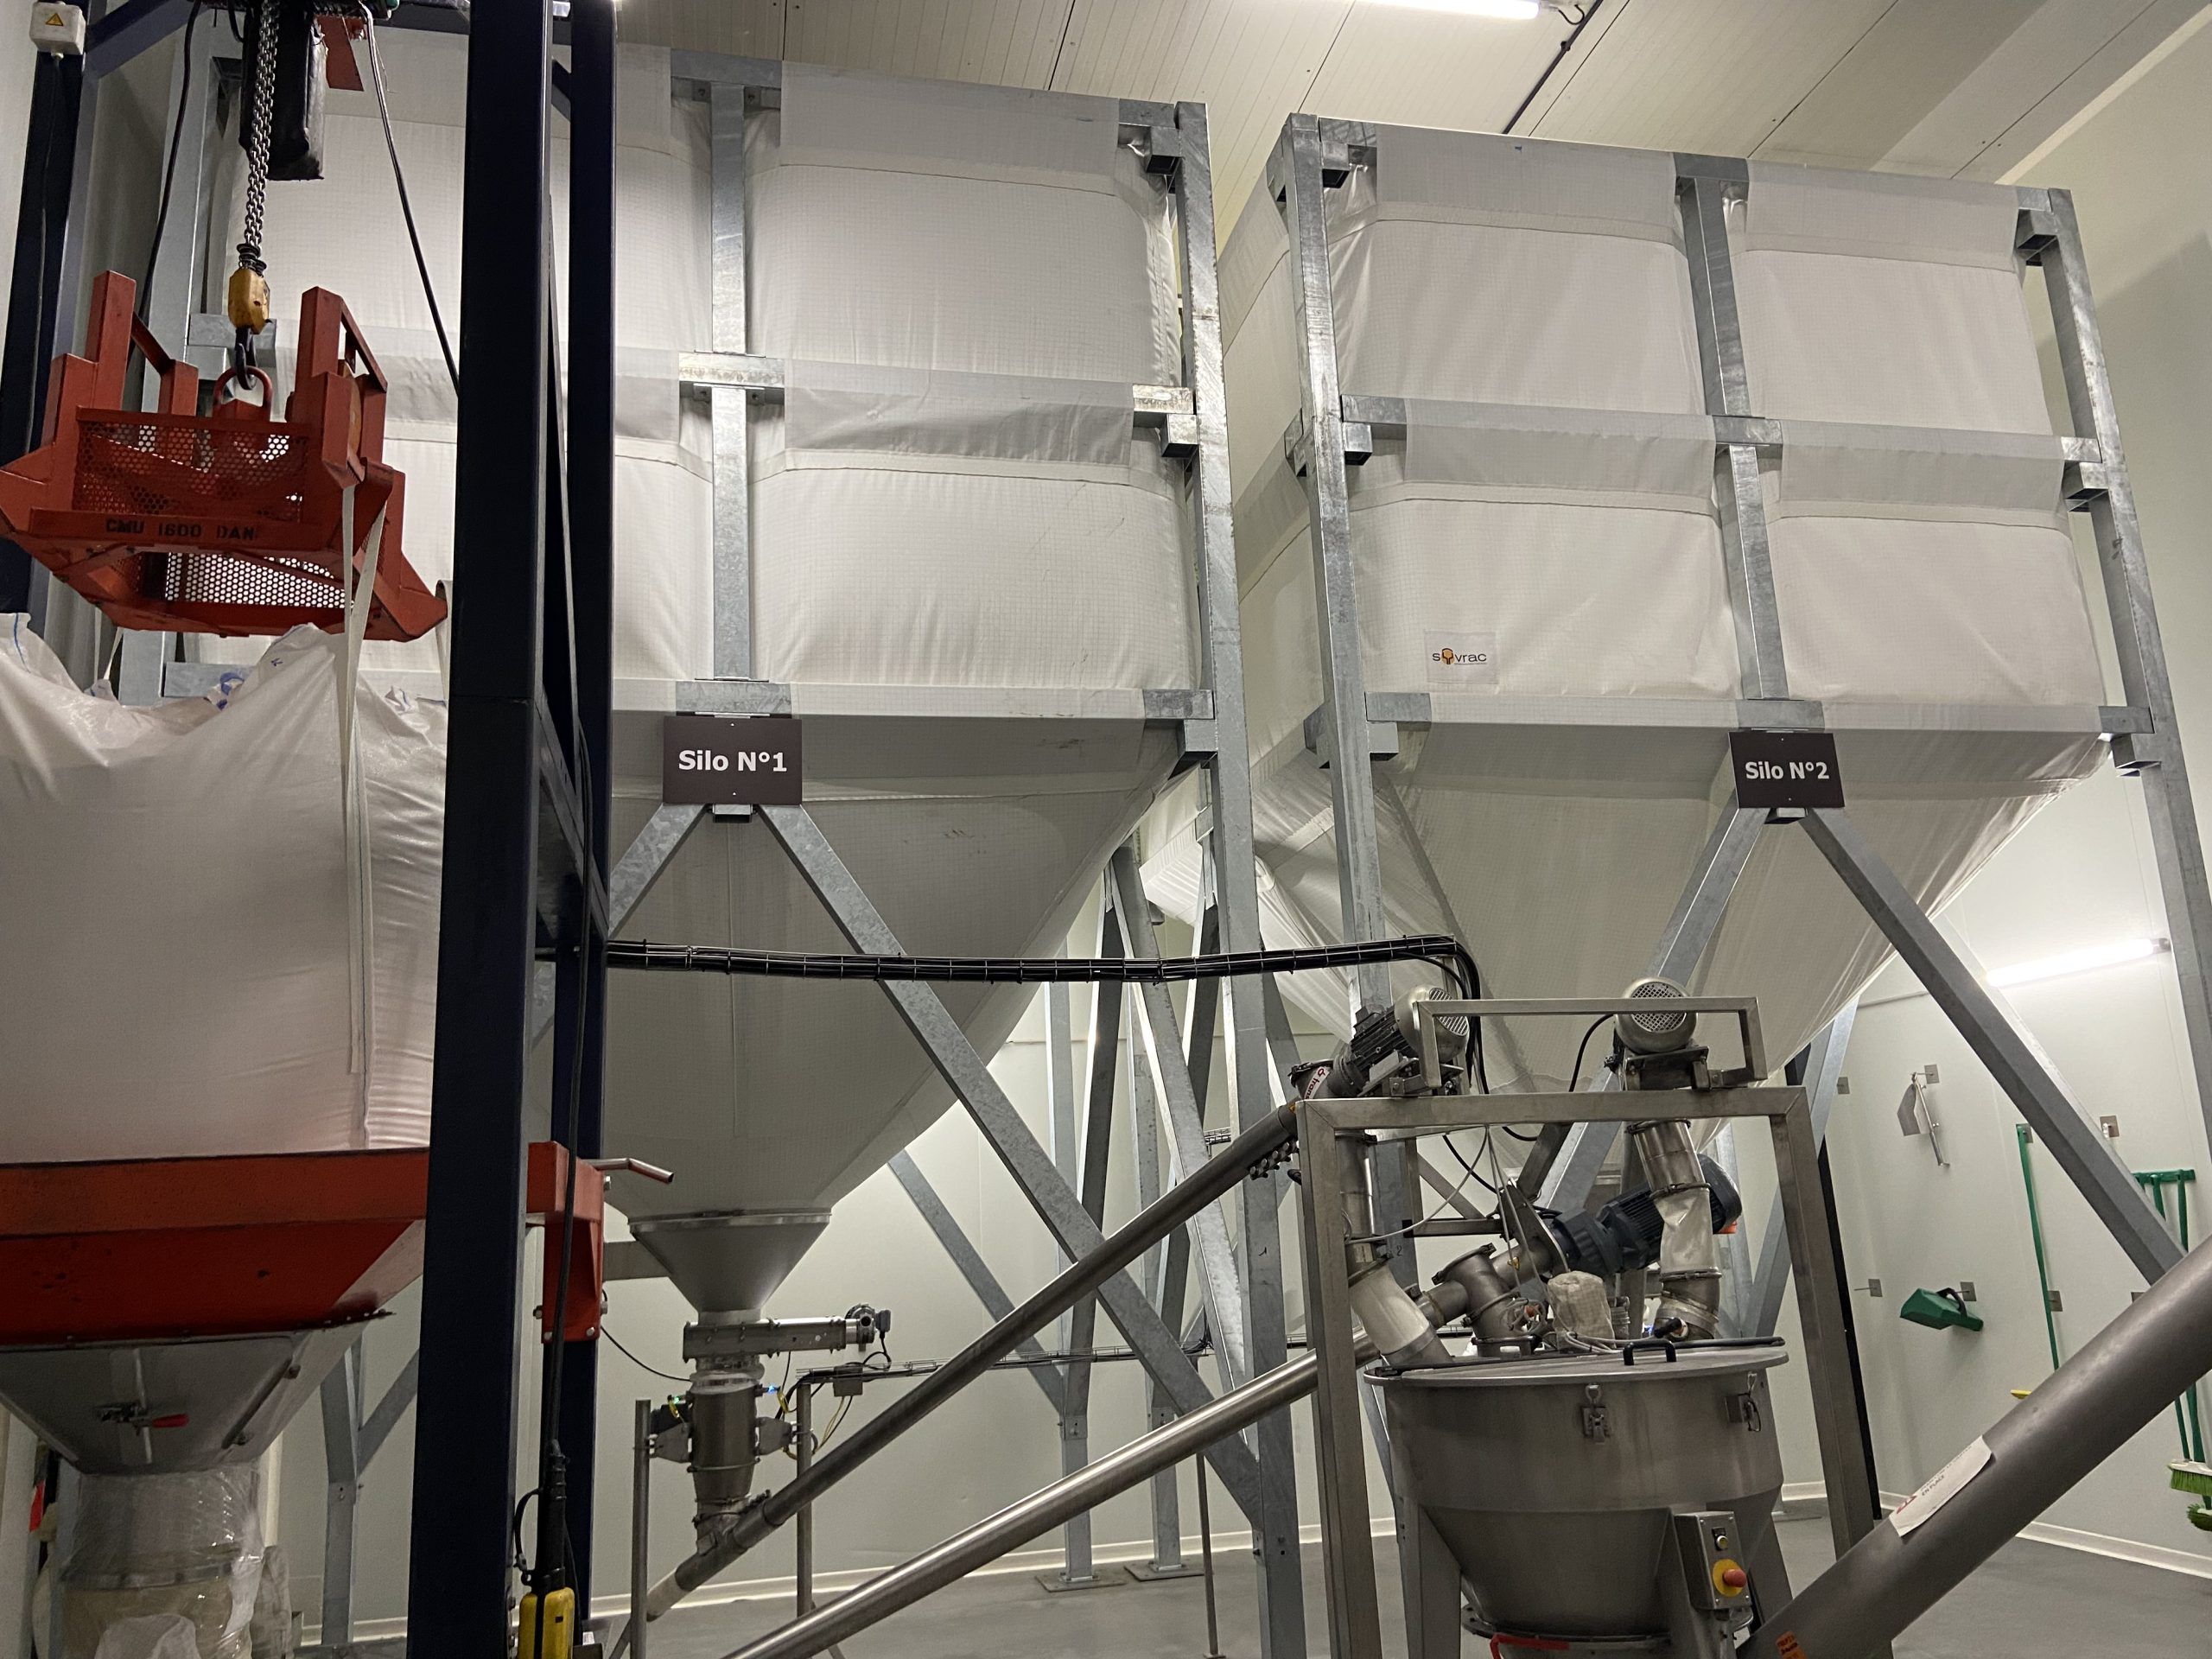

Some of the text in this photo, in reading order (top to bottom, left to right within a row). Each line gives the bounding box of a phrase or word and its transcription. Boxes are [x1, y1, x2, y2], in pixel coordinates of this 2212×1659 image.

[105, 518, 255, 541] CMU 1600 DAN
[678, 749, 787, 772] Silo N°1
[1745, 761, 1830, 779] Silo N°2
